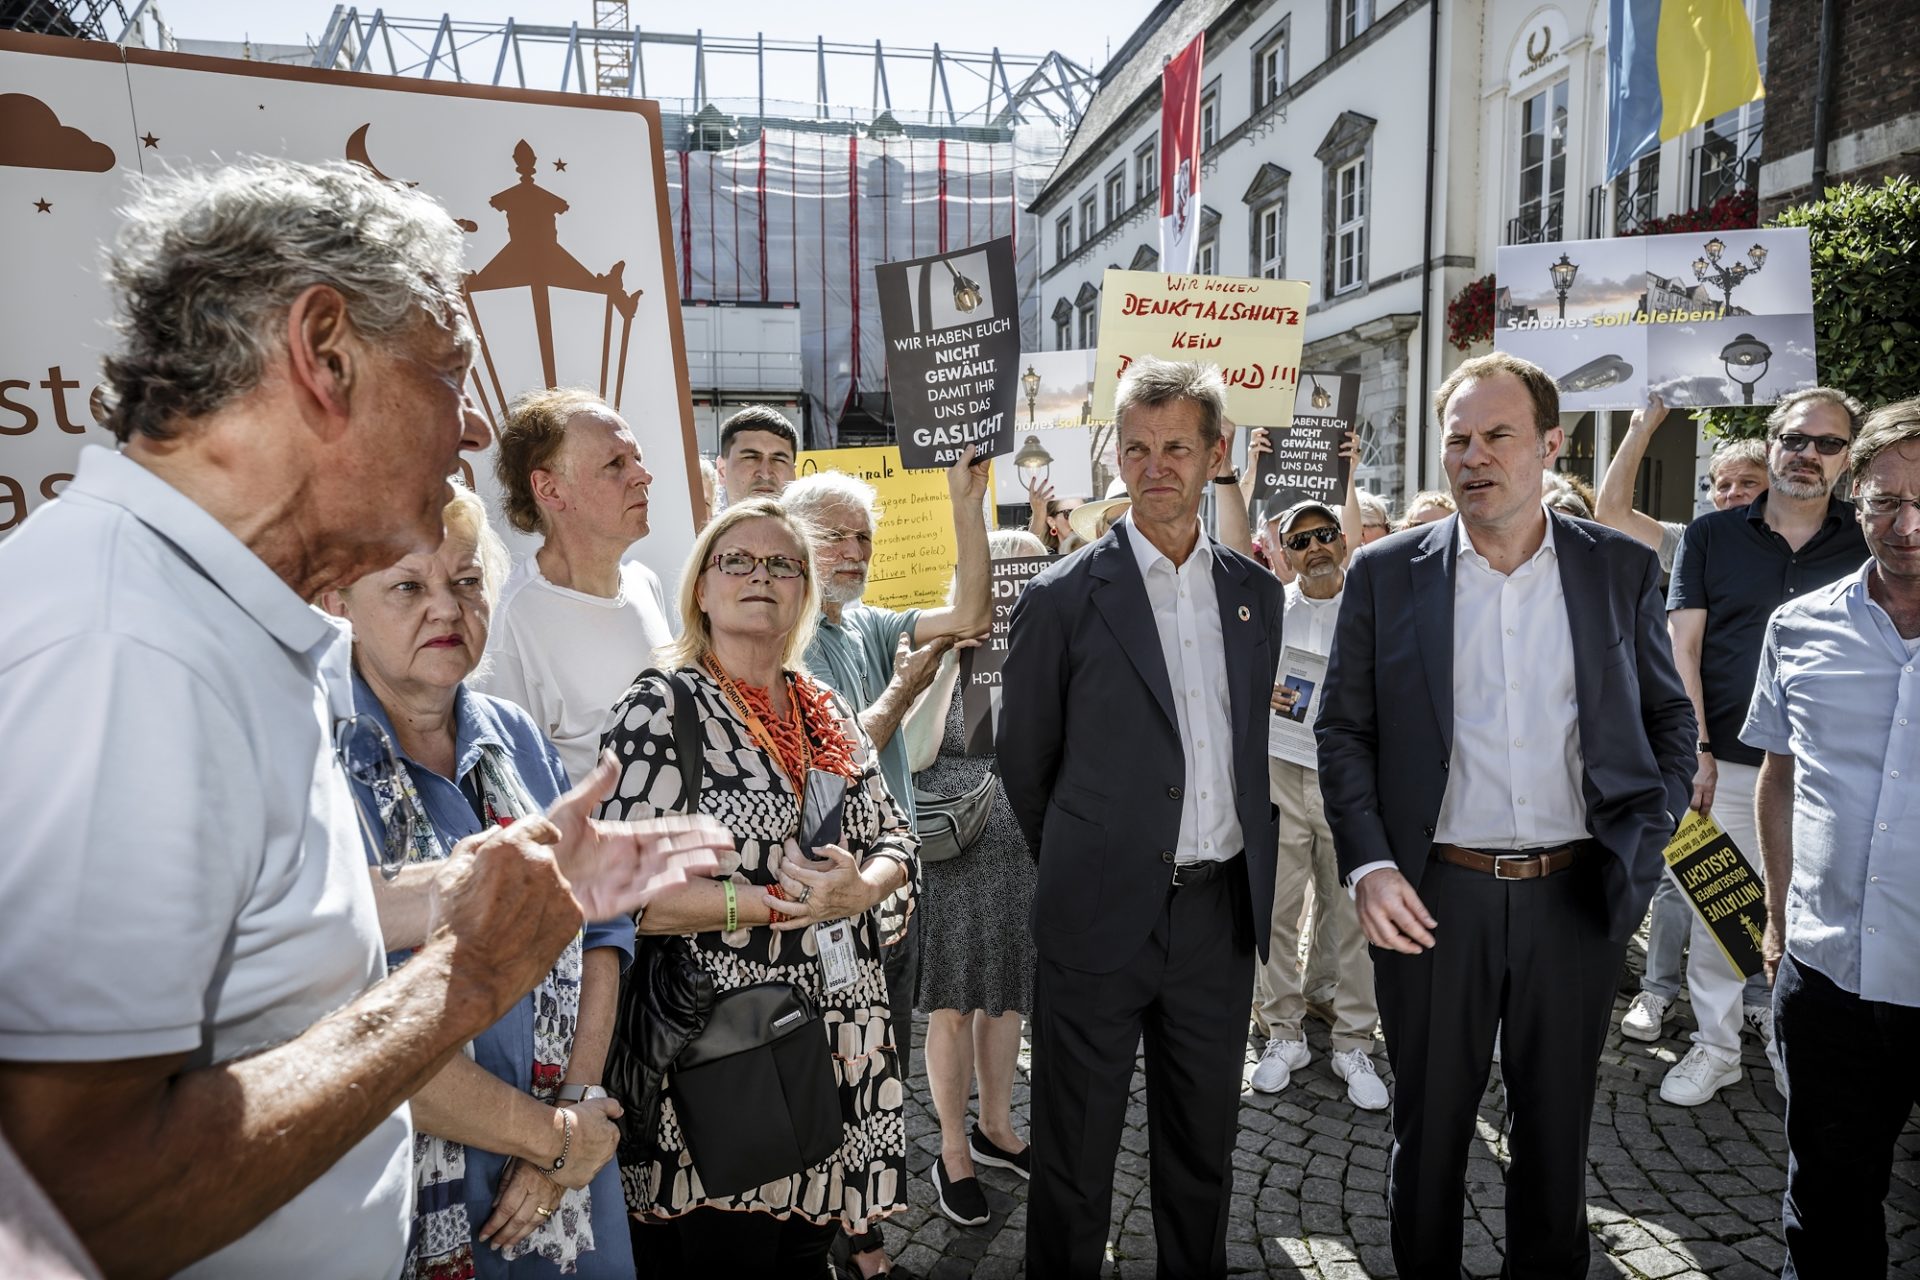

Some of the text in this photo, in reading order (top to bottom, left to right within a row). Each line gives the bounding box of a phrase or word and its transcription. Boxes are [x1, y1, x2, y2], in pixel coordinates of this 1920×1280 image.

[1204, 277, 1260, 293] WOLLEN
[1121, 293, 1299, 325] DENKMALSCHUTZ
[1506, 306, 1726, 332] Schönes soll bleiben!
[894, 317, 1011, 352] WIR HABEN EUCH
[935, 343, 980, 364] NICHT
[925, 359, 998, 384] GEWÄHLT,
[927, 378, 995, 402] DAMIT IHR
[934, 397, 991, 420] UNS DAS
[913, 412, 1004, 447] GASLICHT
[1056, 415, 1083, 430] soll
[1290, 428, 1322, 438] NICHT
[1321, 418, 1348, 429] EUCH
[1280, 450, 1328, 461] DAMIT IHR
[1281, 461, 1323, 472] UNS DAS
[1264, 473, 1338, 490] GASLICHT
[992, 621, 1010, 634] HR
[972, 671, 1002, 685] UCH
[1681, 846, 1738, 890] GASLICHT
[1693, 865, 1749, 903] DÜSSELDORFER
[1703, 881, 1764, 923] INITIATIVE
